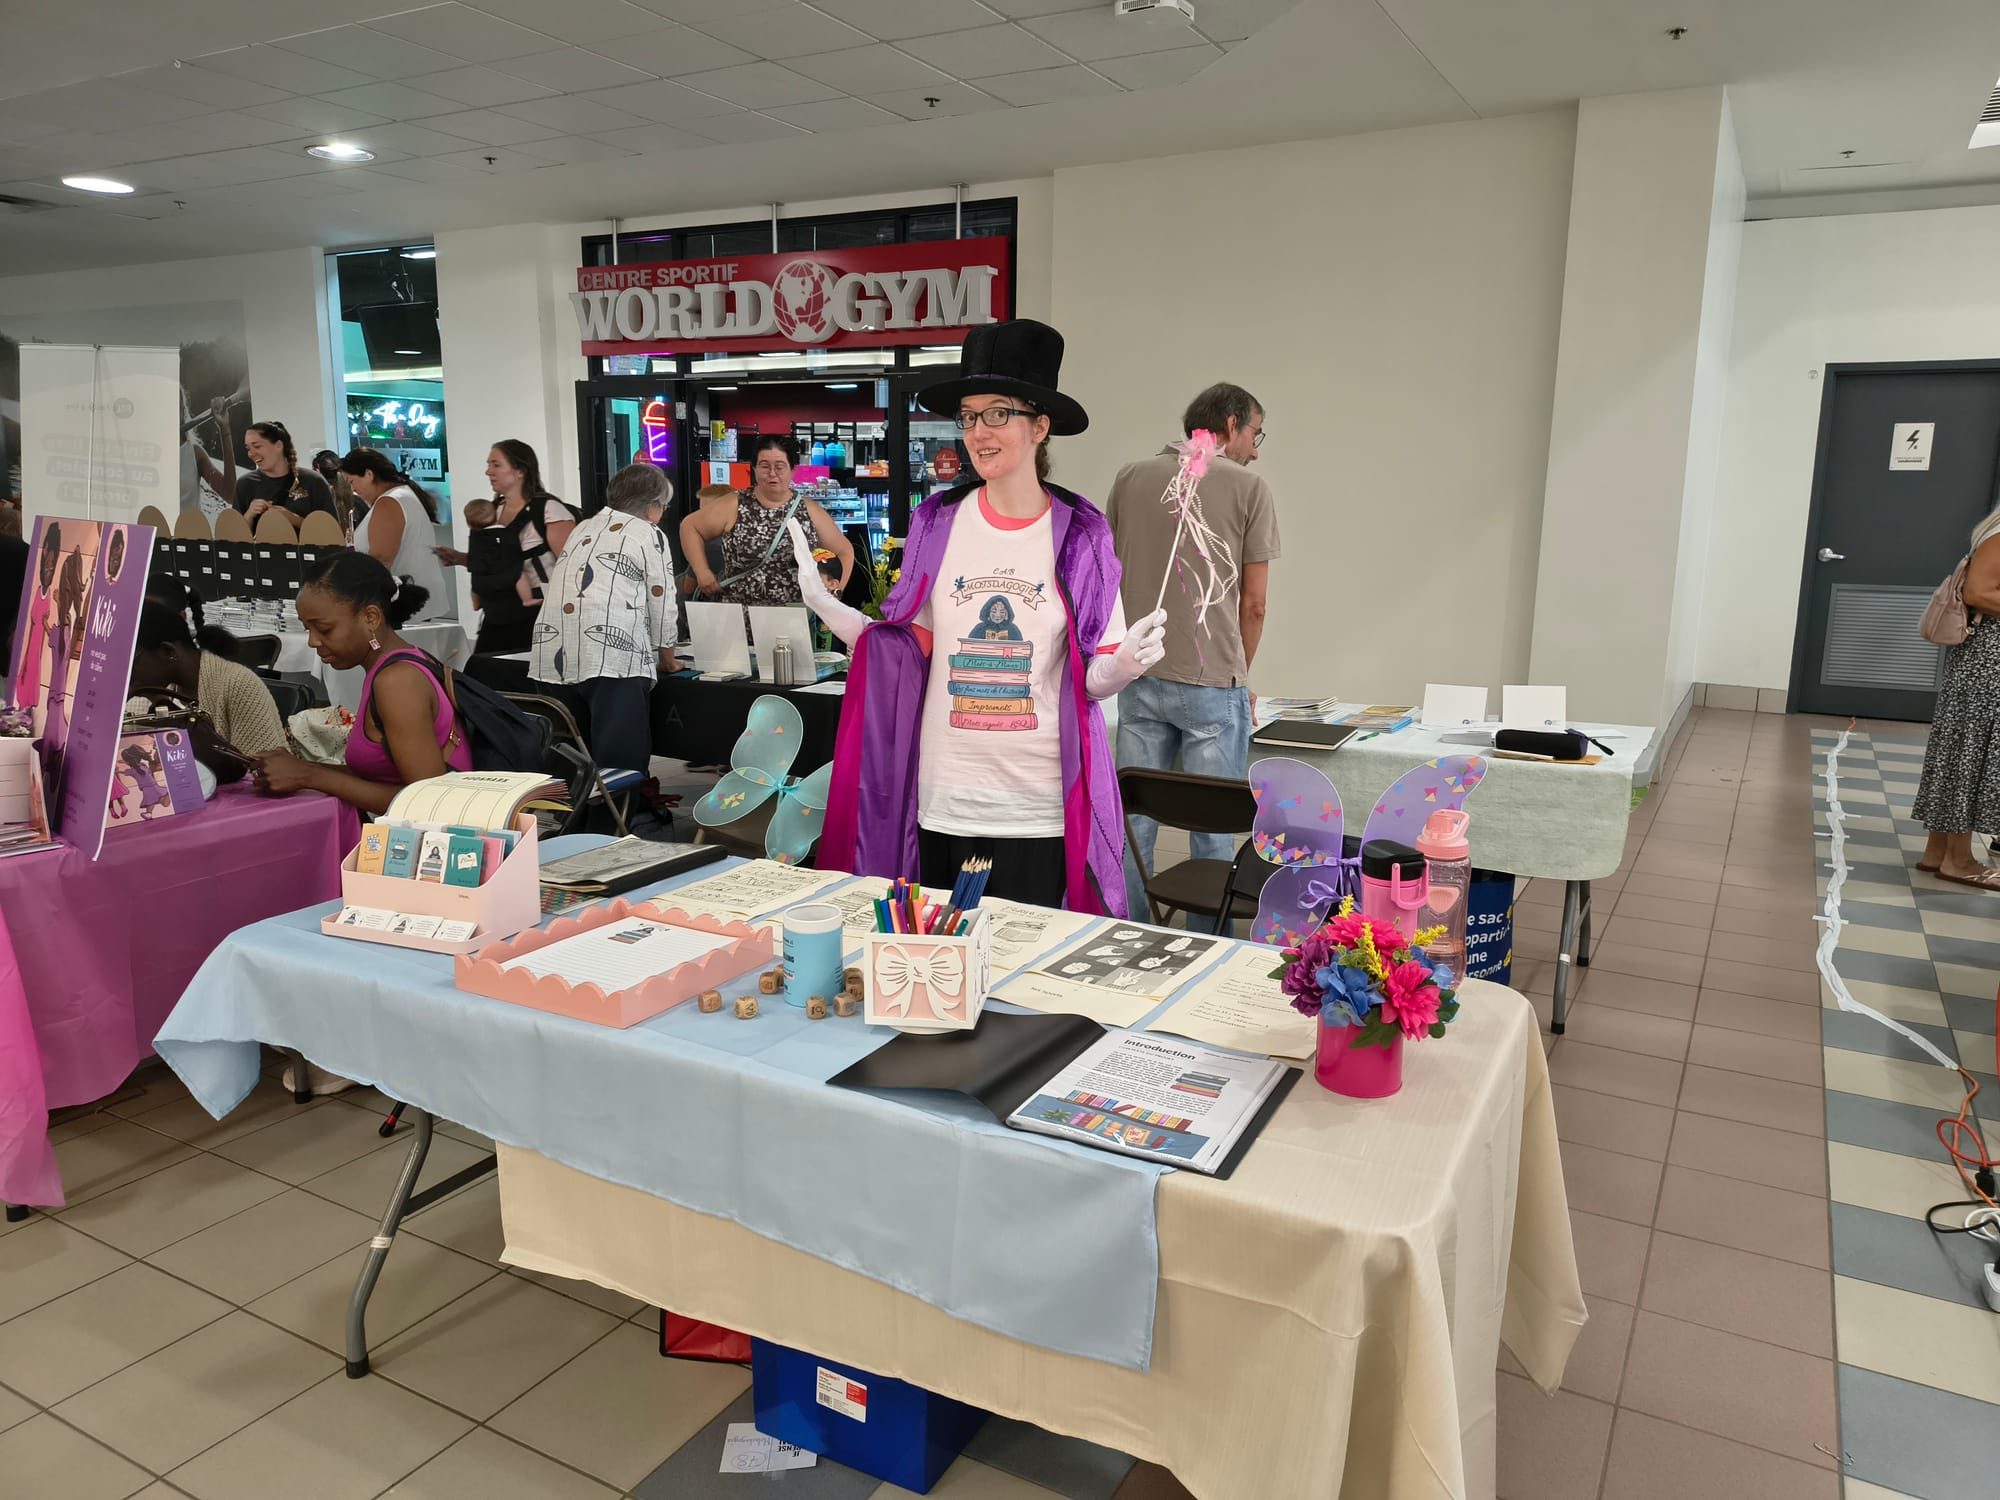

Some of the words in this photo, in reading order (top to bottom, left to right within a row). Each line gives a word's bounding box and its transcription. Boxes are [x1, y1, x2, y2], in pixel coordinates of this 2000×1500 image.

[579, 269, 652, 291] CENTRE
[656, 263, 739, 286] SPORTIF
[569, 280, 777, 342] WORLD
[830, 264, 999, 332] GYM
[407, 403, 440, 439] Day
[993, 567, 1016, 576] CAB
[963, 580, 1036, 596] MOTSDAGOGIE
[91, 595, 116, 643] Kiki
[166, 749, 188, 763] Kiki
[1478, 912, 1505, 926] sac
[1124, 1039, 1196, 1061] Introduction
